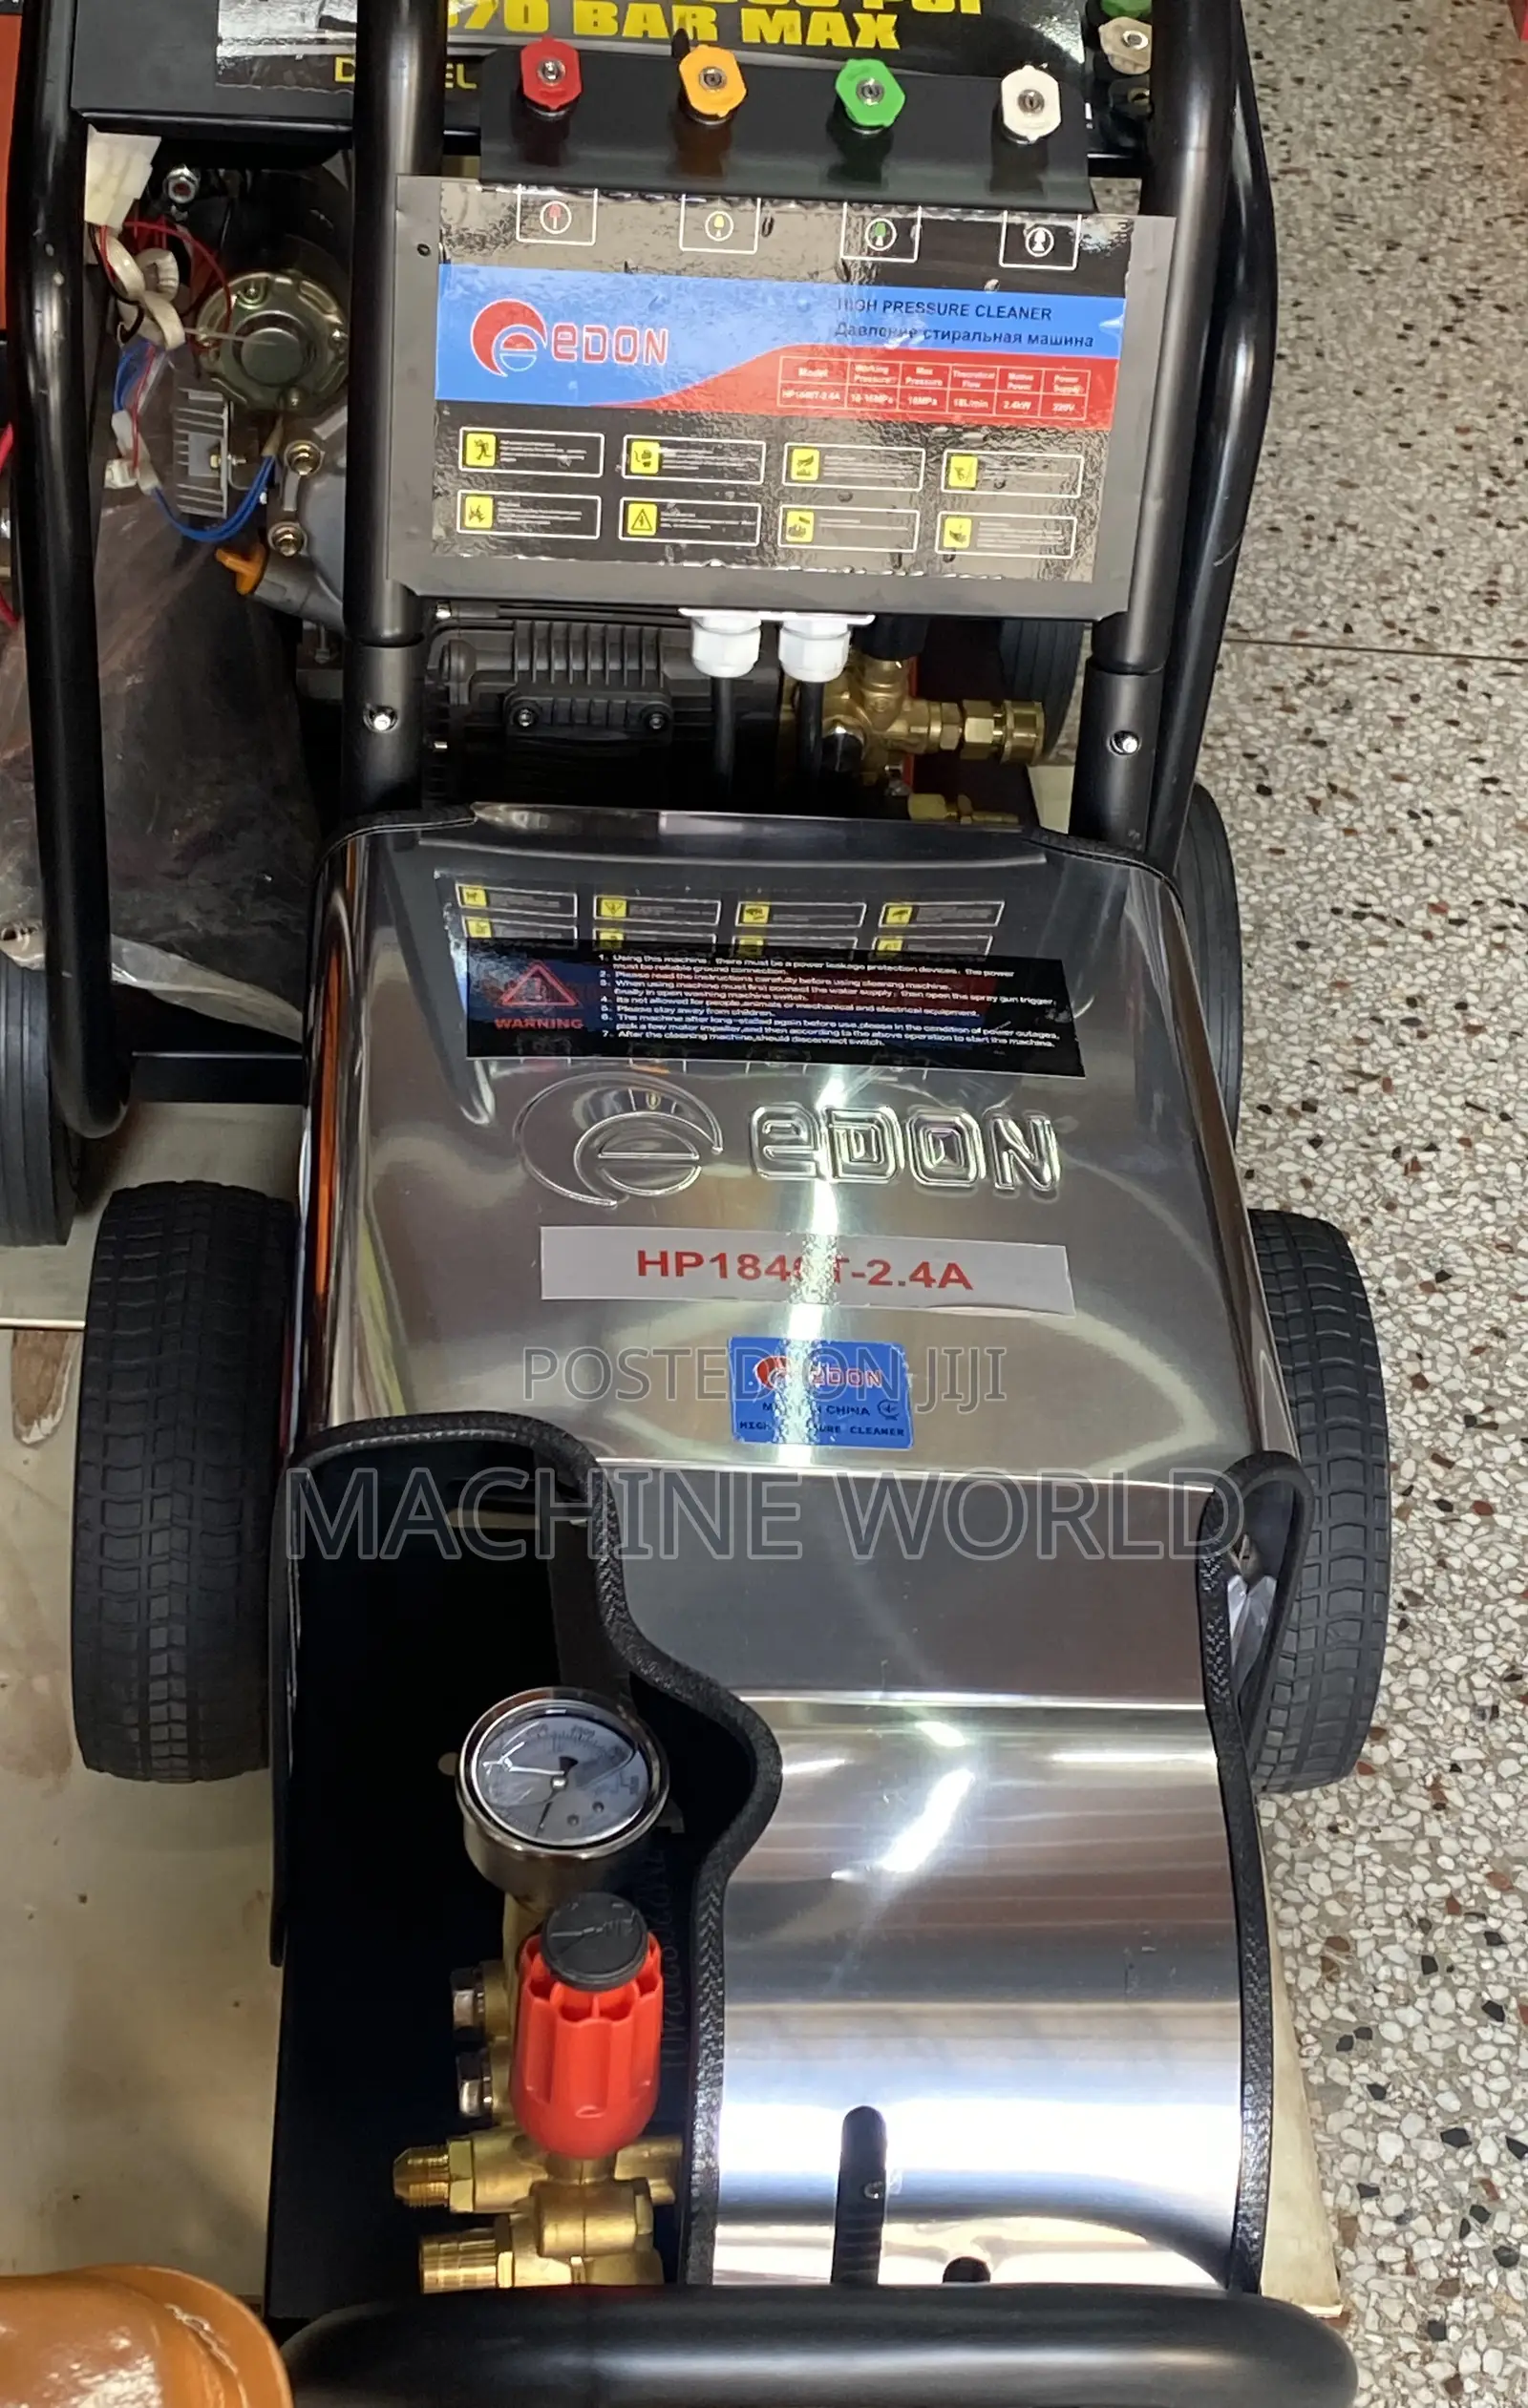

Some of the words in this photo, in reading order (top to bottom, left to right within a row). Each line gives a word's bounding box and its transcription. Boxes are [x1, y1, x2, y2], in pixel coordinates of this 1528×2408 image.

[447, 0, 549, 32] 70
[573, 1, 718, 41] BAR
[741, 8, 900, 50] MAX
[882, 301, 970, 317] PRESSURE
[975, 304, 1051, 321] CLEANER
[923, 327, 1022, 345] стиральная
[1027, 334, 1094, 349] машина
[694, 974, 753, 982] instructions
[755, 976, 797, 984] carefully
[657, 989, 682, 998] open
[684, 990, 727, 999] washing
[728, 991, 771, 1000] machine
[970, 994, 998, 1003] spray
[877, 1005, 922, 1014] electrical
[495, 1018, 584, 1029] WARNING
[923, 1024, 969, 1033] condition
[790, 1028, 839, 1037] according
[904, 1032, 952, 1042] operation
[792, 1036, 847, 1045] disconnect
[637, 1250, 974, 1290] HP184T-2.4A
[826, 1405, 871, 1416] CHINA
[850, 1426, 904, 1437] CLEANER
